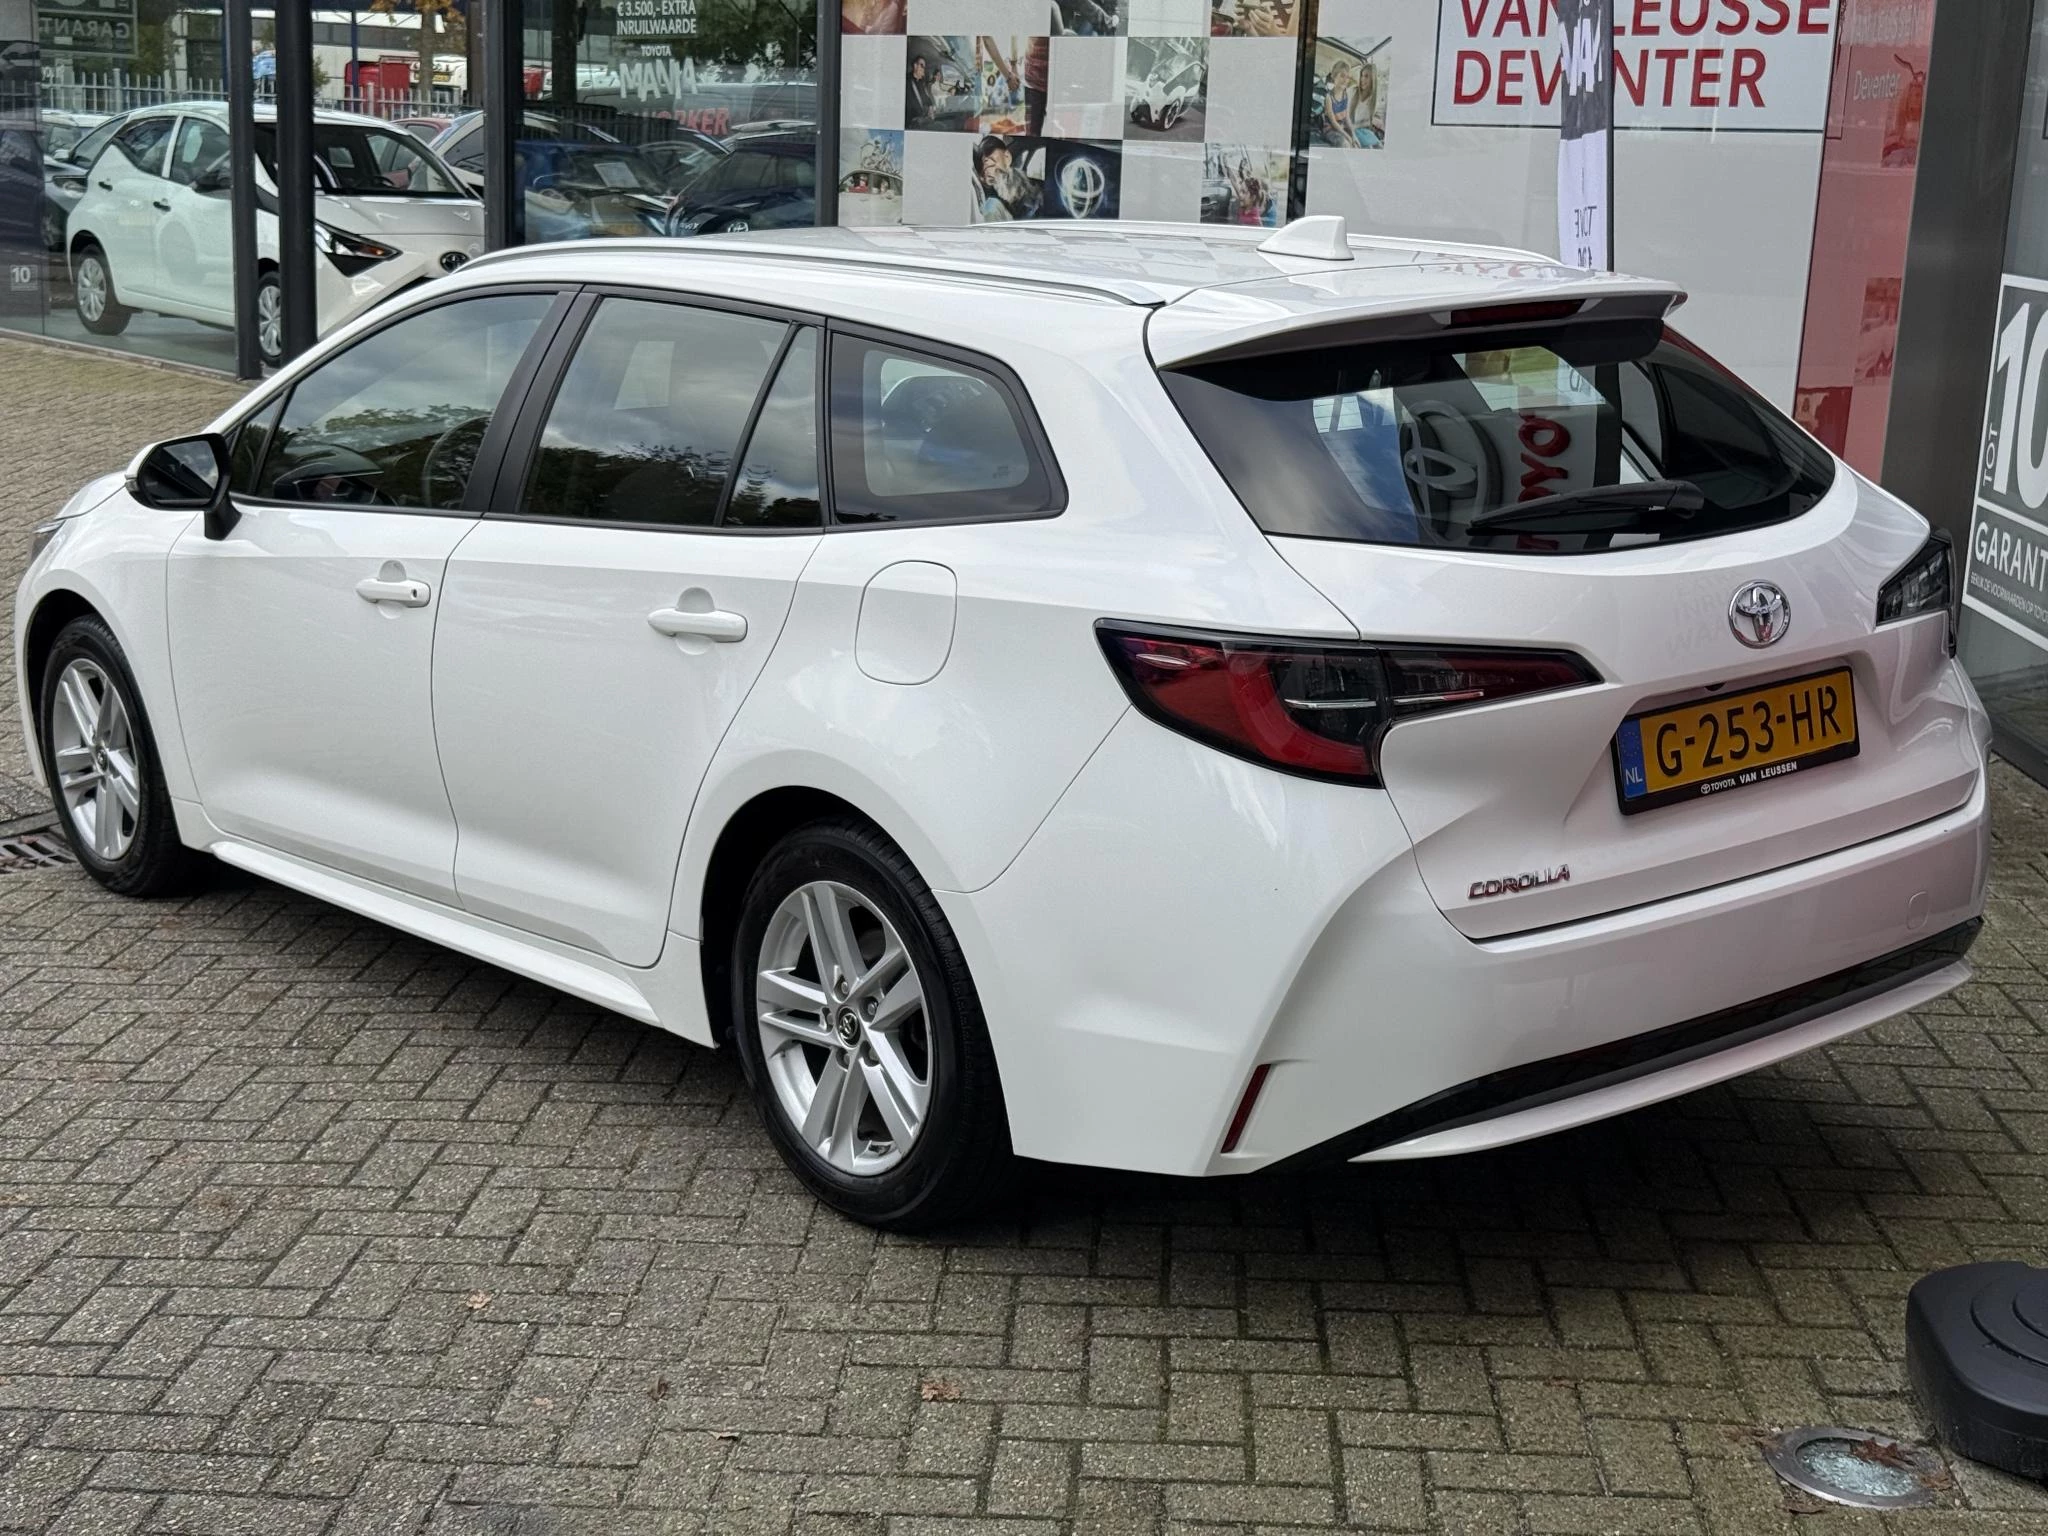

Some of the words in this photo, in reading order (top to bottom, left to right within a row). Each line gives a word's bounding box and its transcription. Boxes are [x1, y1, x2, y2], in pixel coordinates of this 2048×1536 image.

[662, 0, 697, 15] EXTRA
[617, 19, 697, 35] INRUILWAARDE
[641, 45, 672, 57] TOYOTA
[620, 57, 698, 102] MANIA
[1454, 48, 1766, 107] DEVNTER
[1853, 69, 1901, 101] Deventer
[12, 267, 31, 283] 10
[1983, 424, 1998, 487] TOT
[1656, 685, 1841, 777] G-253-HR
[1625, 767, 1643, 785] NL
[1711, 778, 1736, 791] TOYOTA
[1739, 772, 1757, 784] VAN
[1760, 761, 1797, 779] LEUSSEN
[1468, 864, 1570, 899] COROLLA
